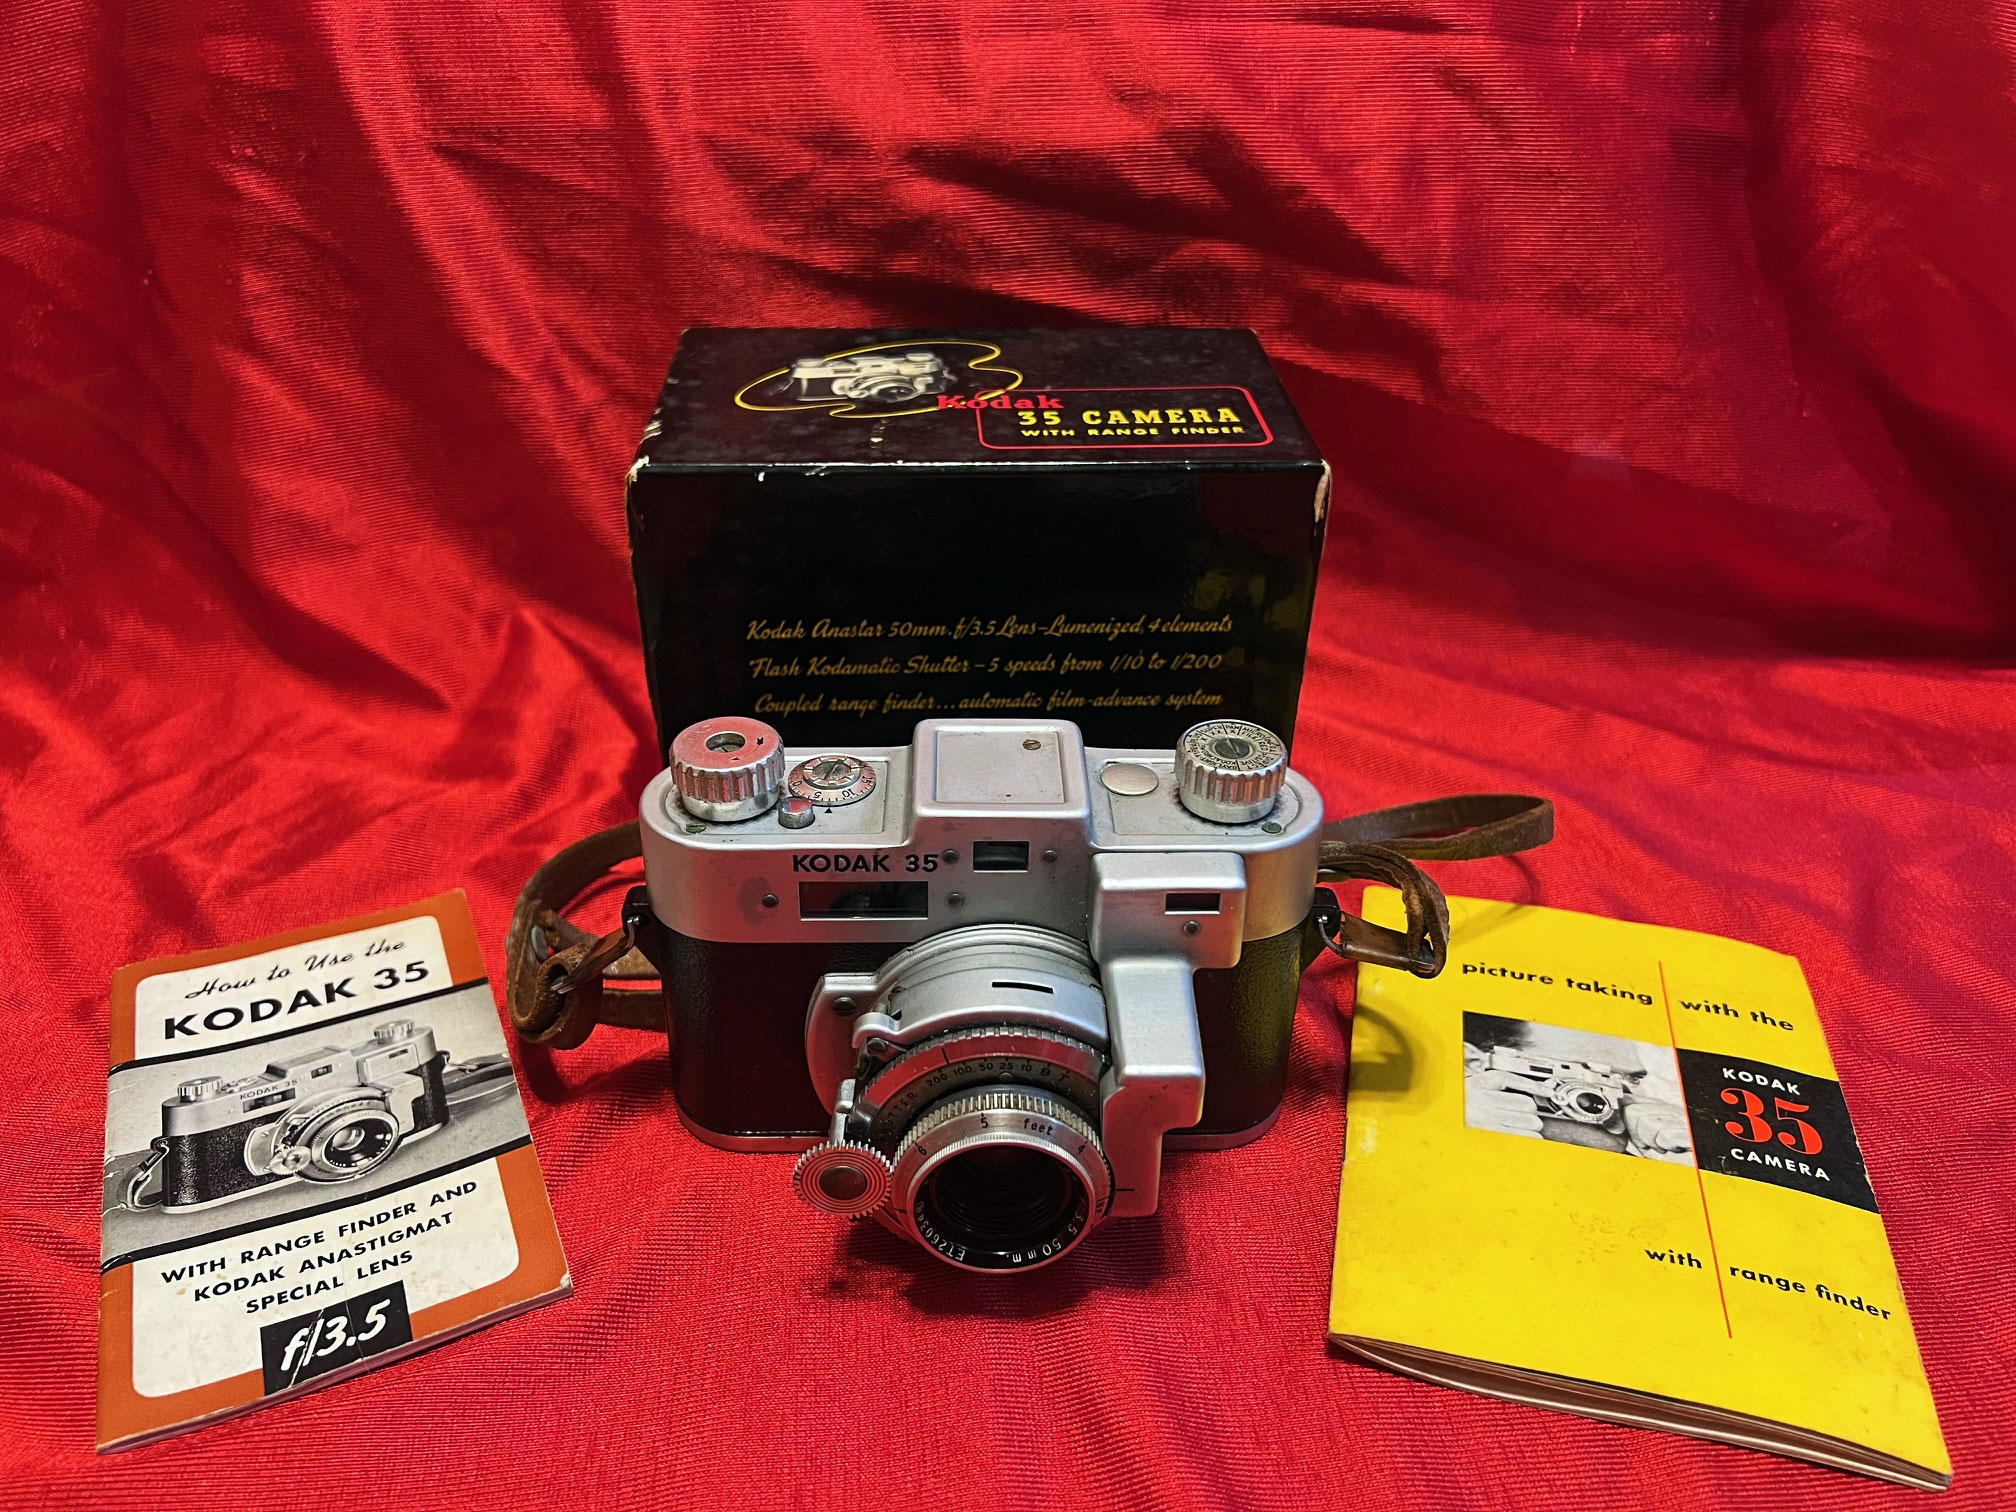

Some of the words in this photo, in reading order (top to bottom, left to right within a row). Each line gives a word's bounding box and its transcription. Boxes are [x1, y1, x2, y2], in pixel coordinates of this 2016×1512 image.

[937, 395, 1064, 409] Kodak
[1017, 411, 1062, 425] 35
[1082, 408, 1241, 425] CAMERA
[1020, 429, 1075, 437] WITH
[1088, 427, 1159, 436] RANGE
[1171, 426, 1246, 435] FINDER
[746, 619, 806, 640] Kodak
[811, 618, 885, 639] Anastar
[1148, 618, 1161, 633] 4
[1161, 613, 1233, 633] elements
[749, 656, 801, 678] Flash
[807, 656, 900, 676] Kodamatic
[904, 655, 971, 674] Shutter
[987, 657, 1000, 673] 5
[1004, 653, 1056, 678] speeds
[1059, 652, 1104, 675] from
[1109, 654, 1144, 673] 1/10
[1148, 652, 1167, 670] to
[1170, 652, 1223, 671] 1/200
[754, 692, 824, 718] Coupled
[829, 696, 879, 718] range
[1163, 688, 1223, 711] system
[813, 791, 822, 799] 5
[842, 788, 856, 797] 10
[792, 854, 890, 873] KODAK
[905, 854, 939, 873] 35
[184, 978, 257, 999] How
[266, 964, 292, 981] to
[304, 953, 354, 972] Use
[364, 939, 406, 957] the
[164, 977, 357, 1040] KODAK
[373, 960, 429, 990] 35
[1462, 962, 1554, 985] picture
[1566, 977, 1653, 1005] taking
[1678, 999, 1739, 1018] with
[1750, 1011, 1794, 1031] the
[926, 1073, 949, 1087] 200
[953, 1065, 972, 1076] 100
[979, 1062, 994, 1071] 50
[1000, 1062, 1014, 1070] 25
[1021, 1064, 1032, 1072] 10
[1040, 1067, 1051, 1077] B
[1058, 1072, 1070, 1082] T
[1722, 1067, 1800, 1095] KODAK
[240, 1085, 279, 1100] KODAK
[1720, 1087, 1823, 1155] 35
[917, 1144, 928, 1156] 6
[980, 1117, 989, 1128] 5
[1023, 1117, 1054, 1135] feet
[1077, 1144, 1086, 1155] 4
[1730, 1148, 1830, 1181] CAMERA
[161, 1257, 227, 1284] WITH
[240, 1231, 325, 1264] RANGE
[338, 1202, 417, 1237] FINDER
[429, 1181, 478, 1207] AND
[1042, 1238, 1062, 1256] 50
[194, 1266, 284, 1302] KODAK
[298, 1212, 453, 1274] ANASTIGMAT
[246, 1276, 344, 1314] SPECIAL
[356, 1250, 413, 1280] LENS
[1644, 1249, 1702, 1269] with
[1729, 1266, 1806, 1293] range
[1815, 1283, 1891, 1320] finder
[280, 1298, 392, 1371] f/3.5
